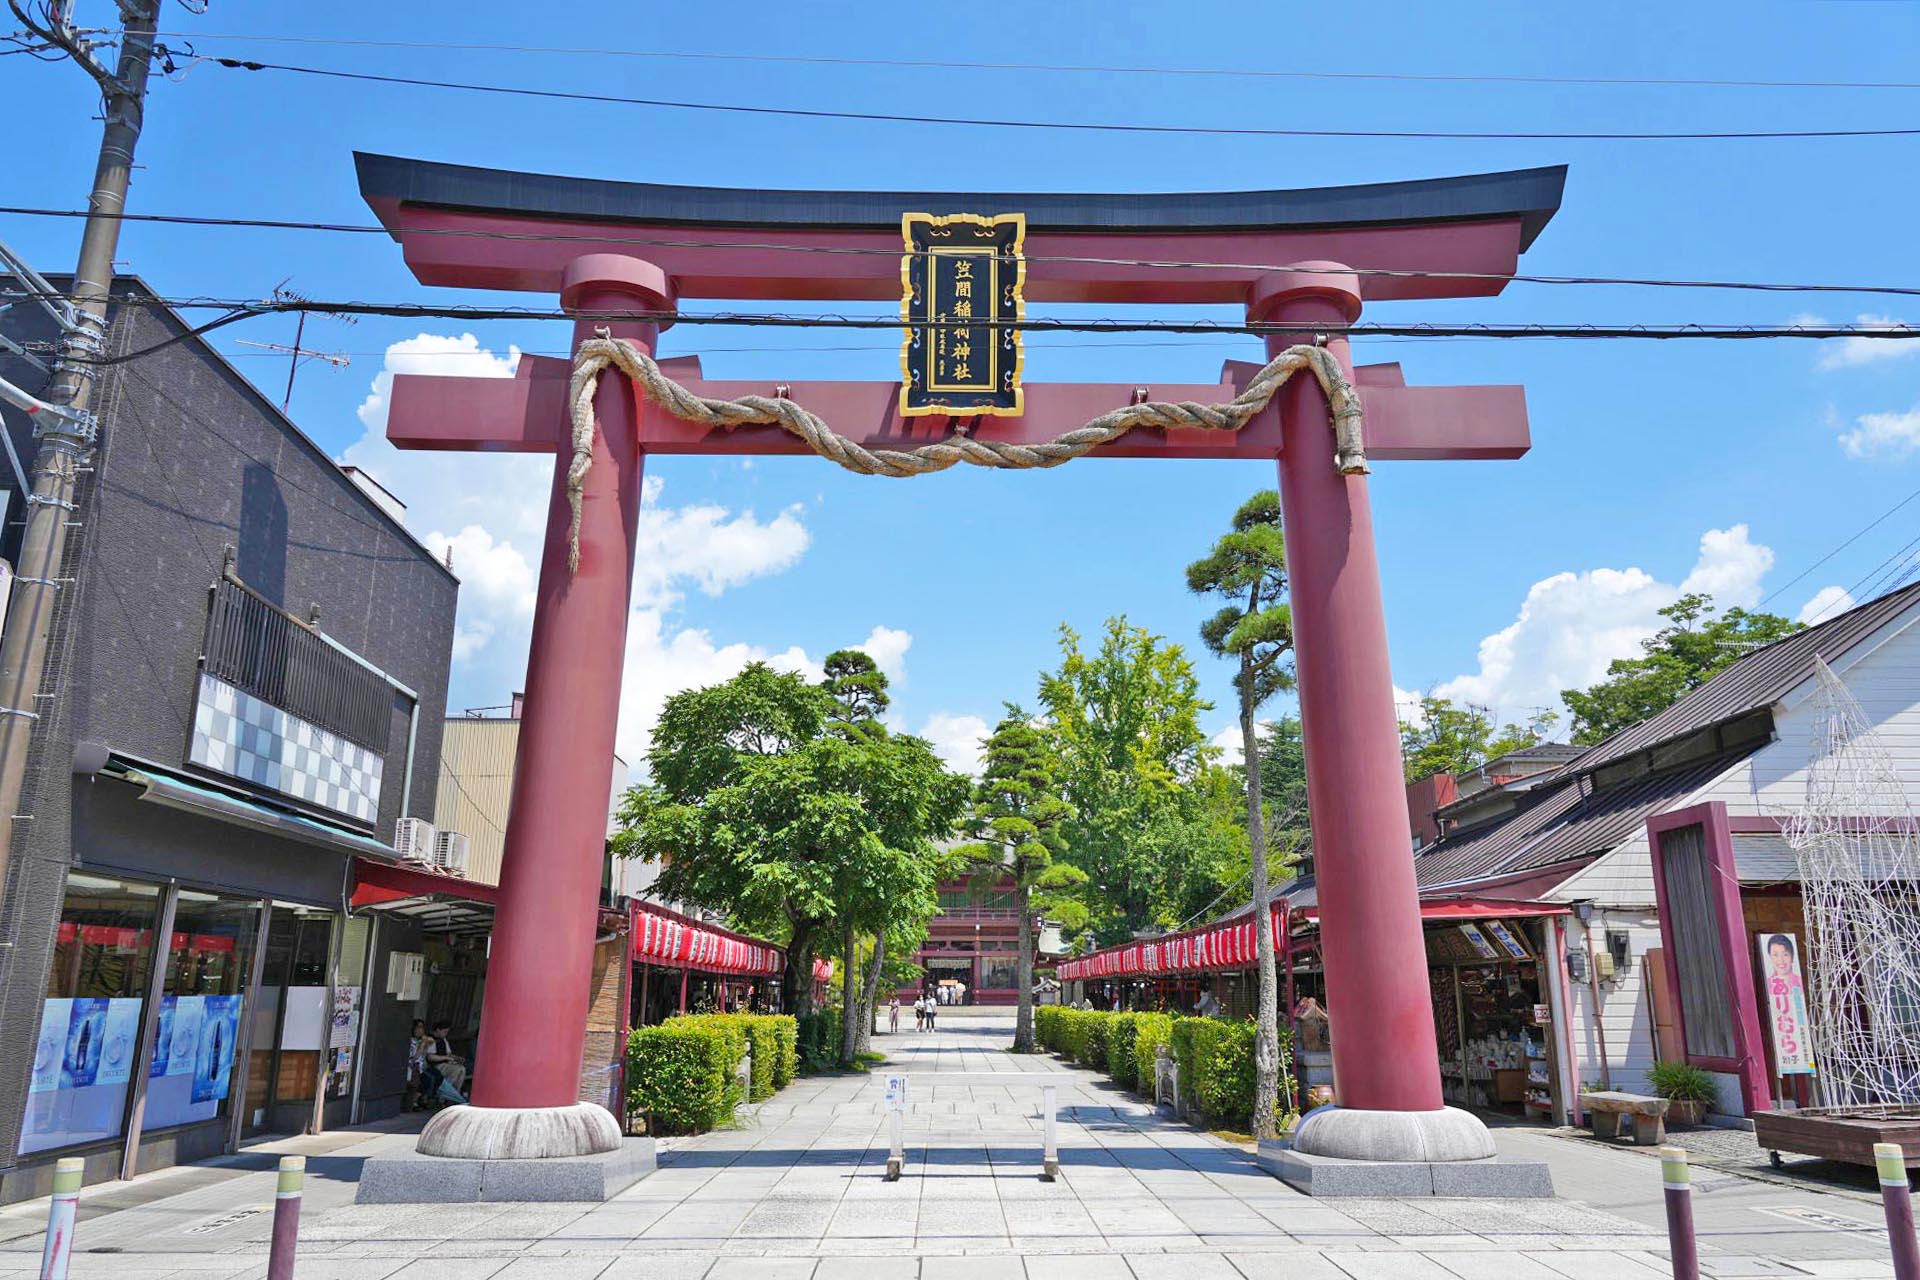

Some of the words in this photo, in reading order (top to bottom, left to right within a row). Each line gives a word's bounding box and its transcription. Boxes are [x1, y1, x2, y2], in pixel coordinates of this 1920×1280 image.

[952, 261, 974, 380] 笠間稲荷神社
[1772, 978, 1797, 1054] ありむら
